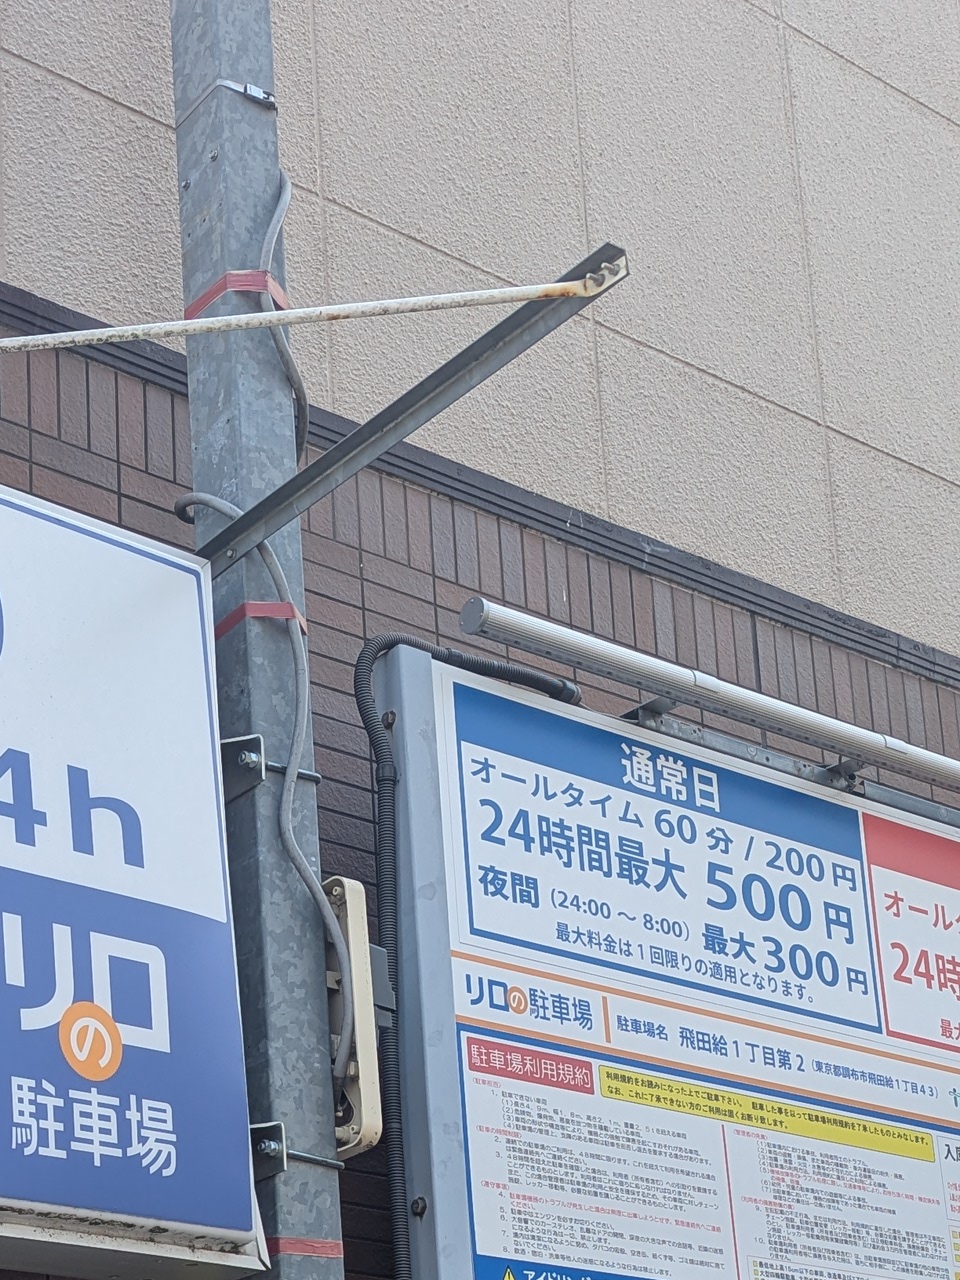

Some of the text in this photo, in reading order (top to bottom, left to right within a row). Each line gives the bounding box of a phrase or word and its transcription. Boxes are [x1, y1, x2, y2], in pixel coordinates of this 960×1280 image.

[620, 741, 721, 813] 通常日
[470, 1043, 591, 1089] 駐車場利用規約
[9, 1075, 178, 1179] 駐車場
